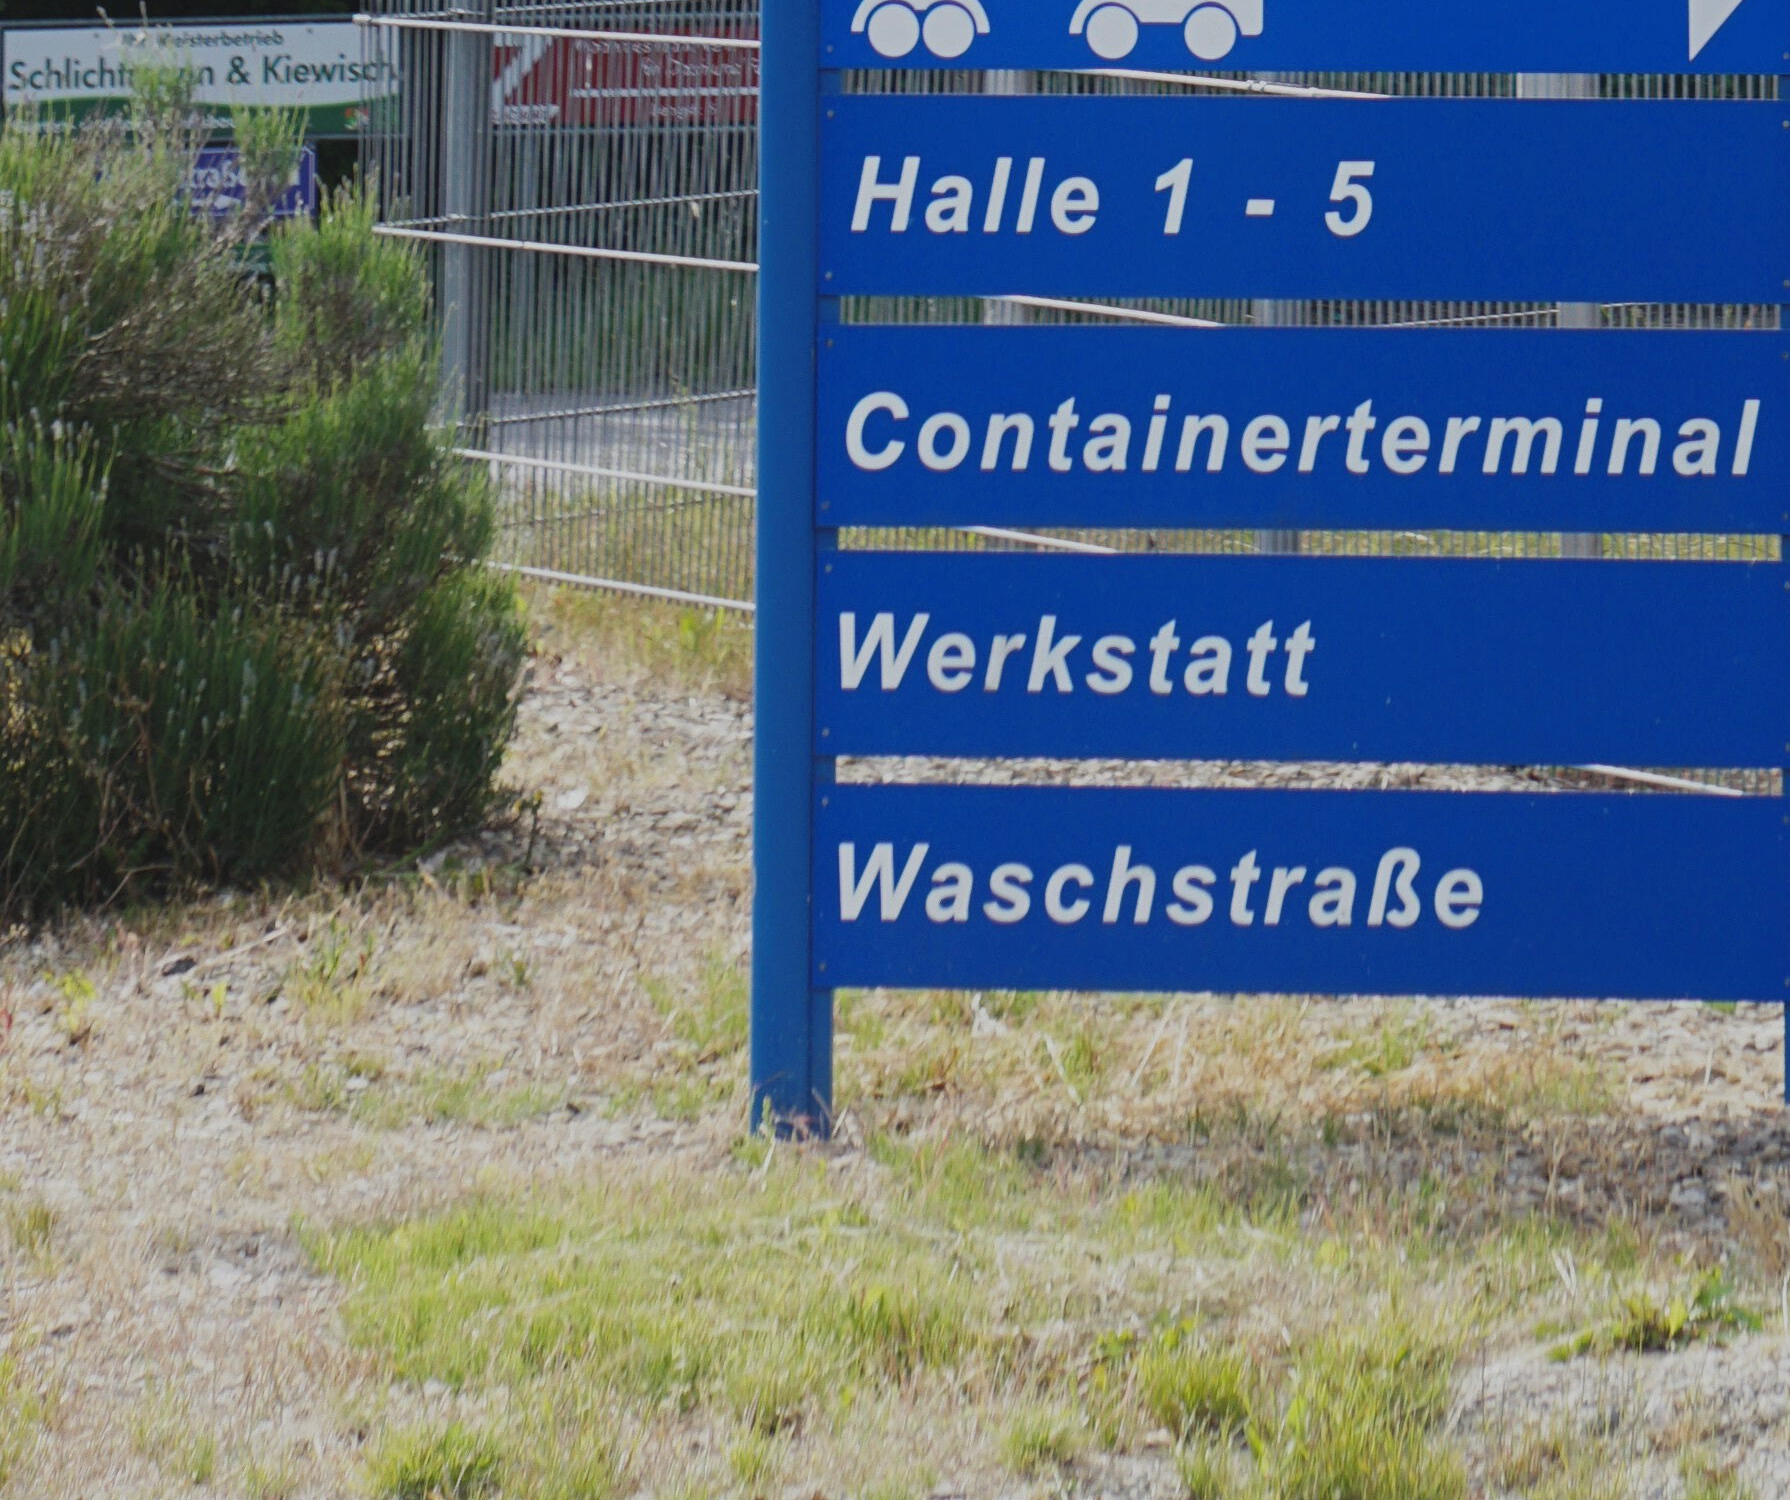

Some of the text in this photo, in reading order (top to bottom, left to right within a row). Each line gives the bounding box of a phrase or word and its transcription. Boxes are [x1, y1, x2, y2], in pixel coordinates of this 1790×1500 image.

[226, 55, 250, 84] &
[850, 154, 1375, 237] Halle 1 - 5
[845, 390, 1760, 477] Containerterminal
[838, 612, 1315, 696] Werkstatt
[838, 842, 1484, 928] Waschstraße
